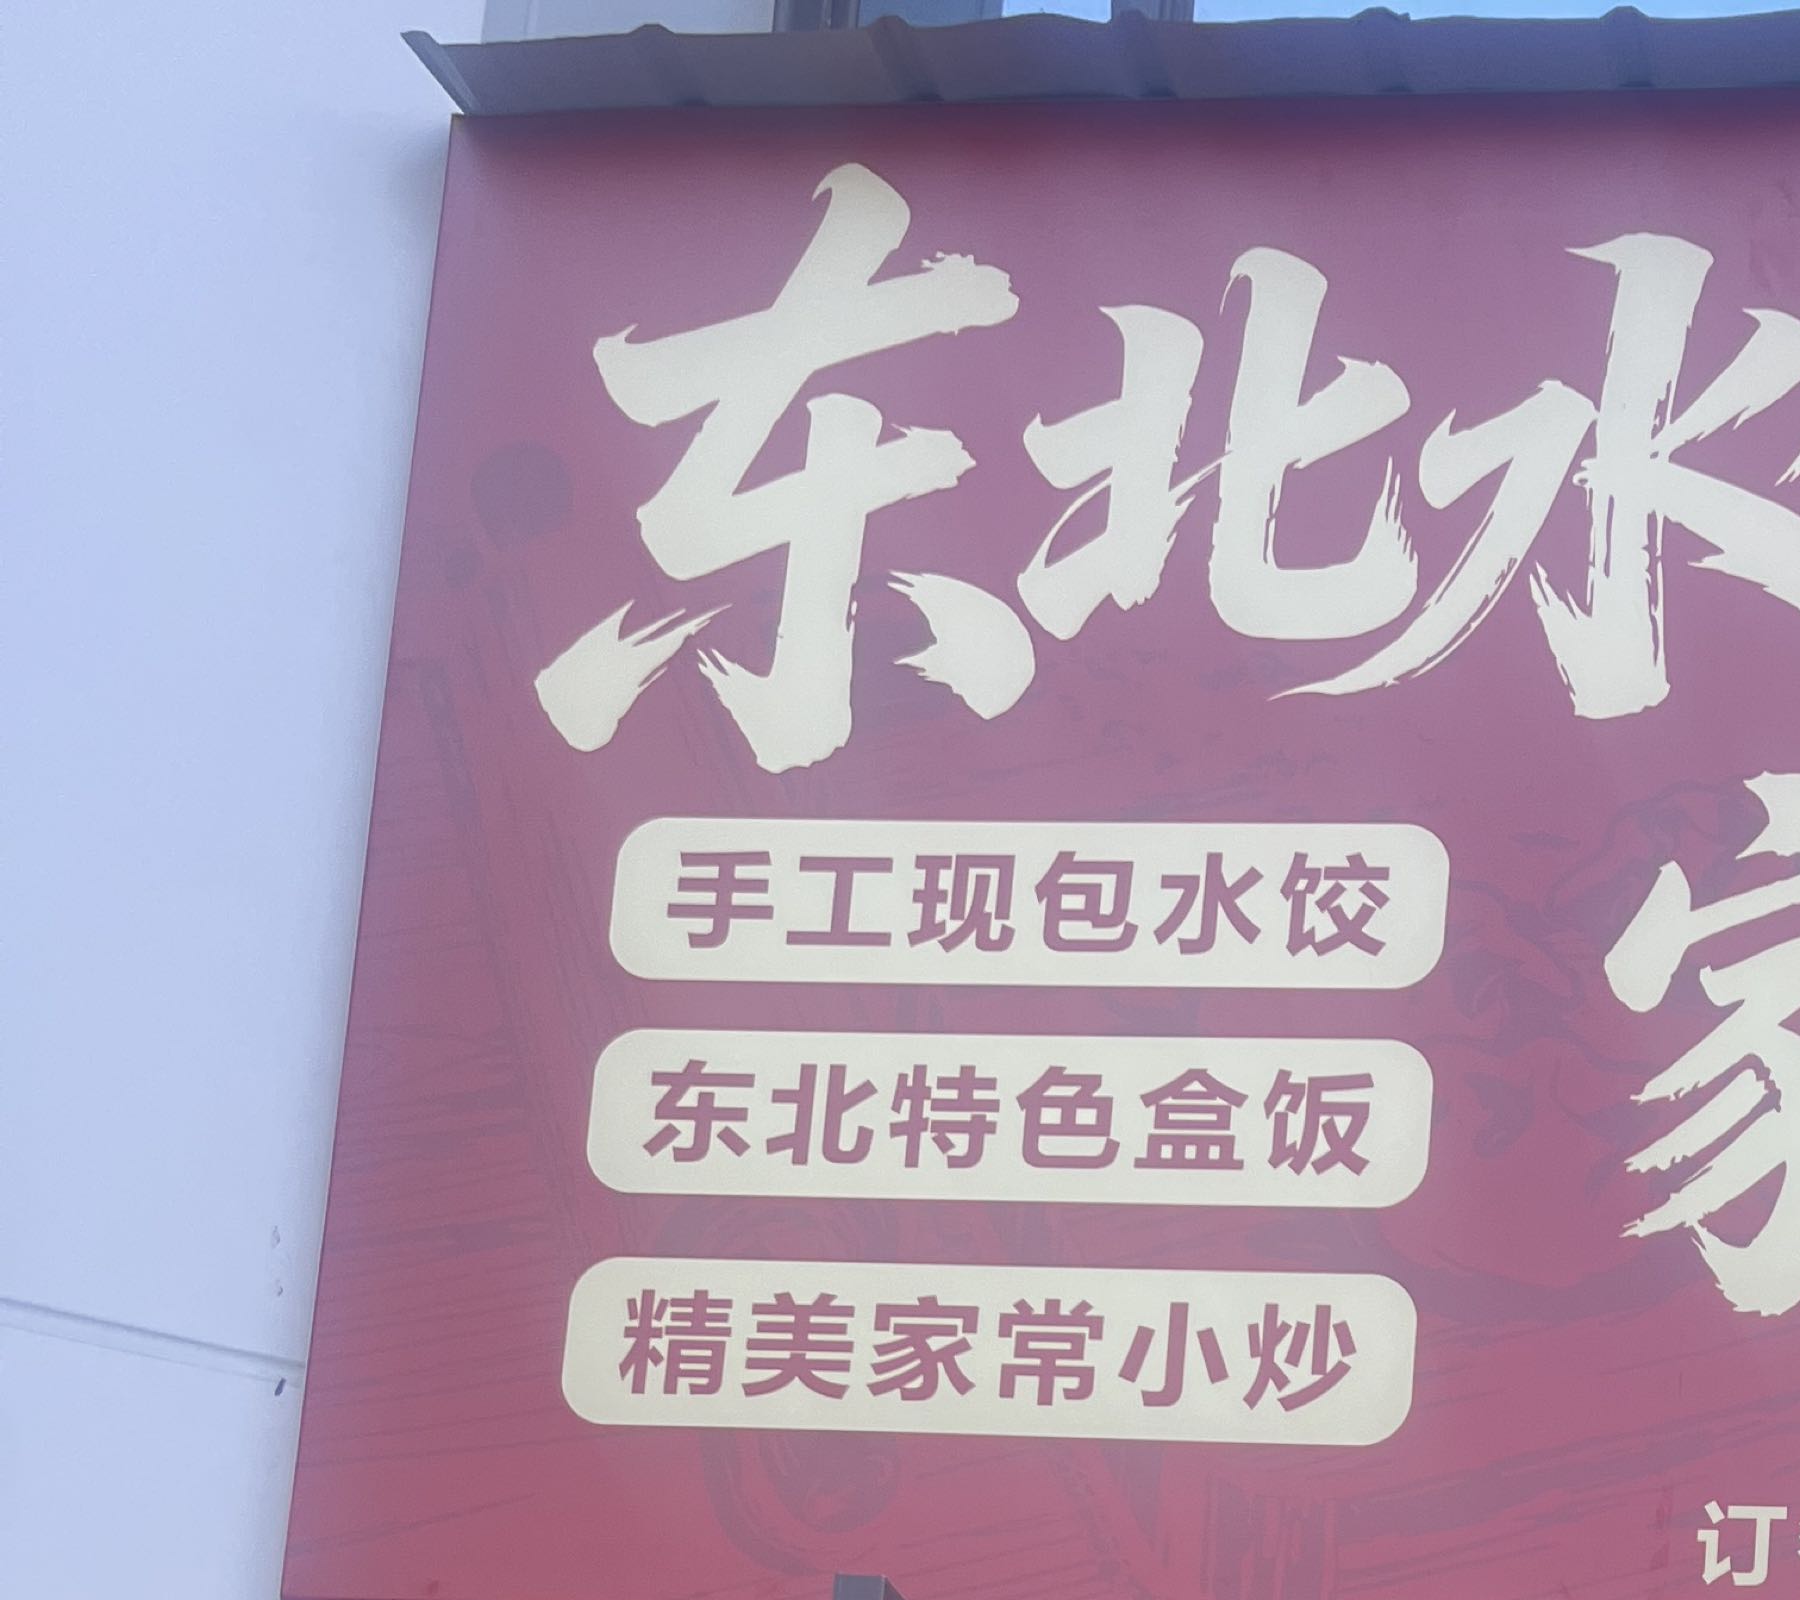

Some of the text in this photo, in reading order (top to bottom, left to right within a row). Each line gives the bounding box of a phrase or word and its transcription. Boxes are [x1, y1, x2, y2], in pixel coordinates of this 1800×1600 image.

[665, 850, 1392, 957] 手工现包水饺
[643, 1058, 1376, 1177] 东北特色盒饭
[618, 1288, 1358, 1413] 精美家常小炒
